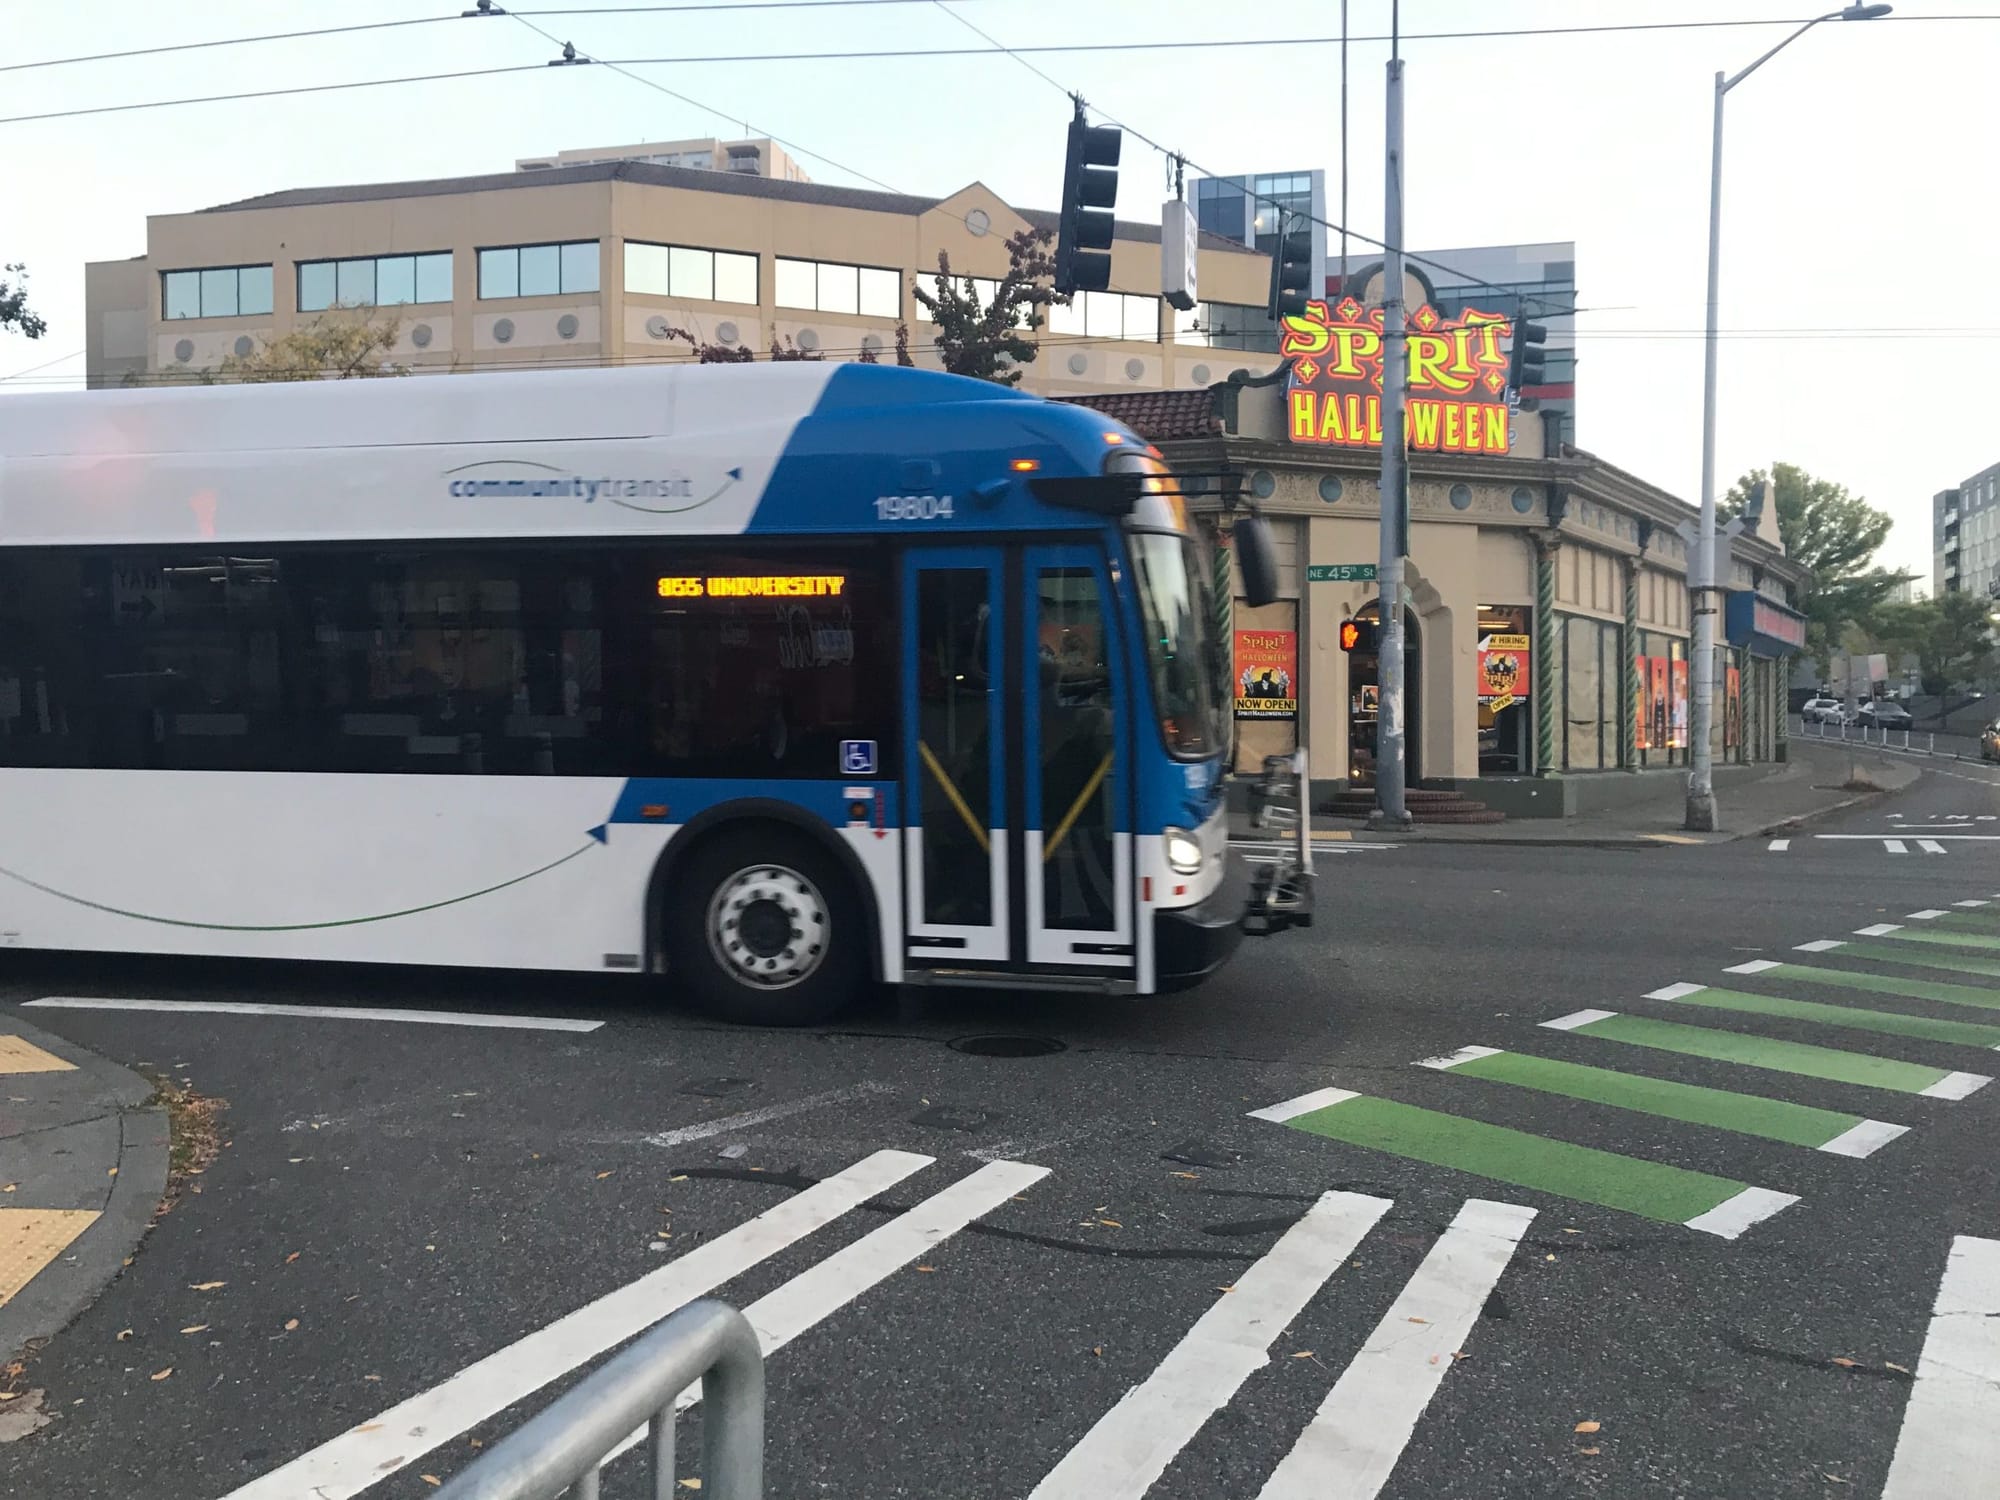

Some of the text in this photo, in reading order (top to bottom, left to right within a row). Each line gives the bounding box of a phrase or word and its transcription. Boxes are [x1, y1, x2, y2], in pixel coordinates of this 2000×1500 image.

[1282, 301, 1511, 393] SPRIT
[1290, 391, 1509, 452] HALLWEEN
[872, 495, 955, 520] 19804
[1309, 566, 1374, 579] NE 45th St
[706, 576, 845, 597] UNIVERSITY
[1242, 634, 1288, 650] SPIRIT
[1241, 652, 1288, 662] HALLOWEEN
[1236, 699, 1295, 709] NOW OPEN!
